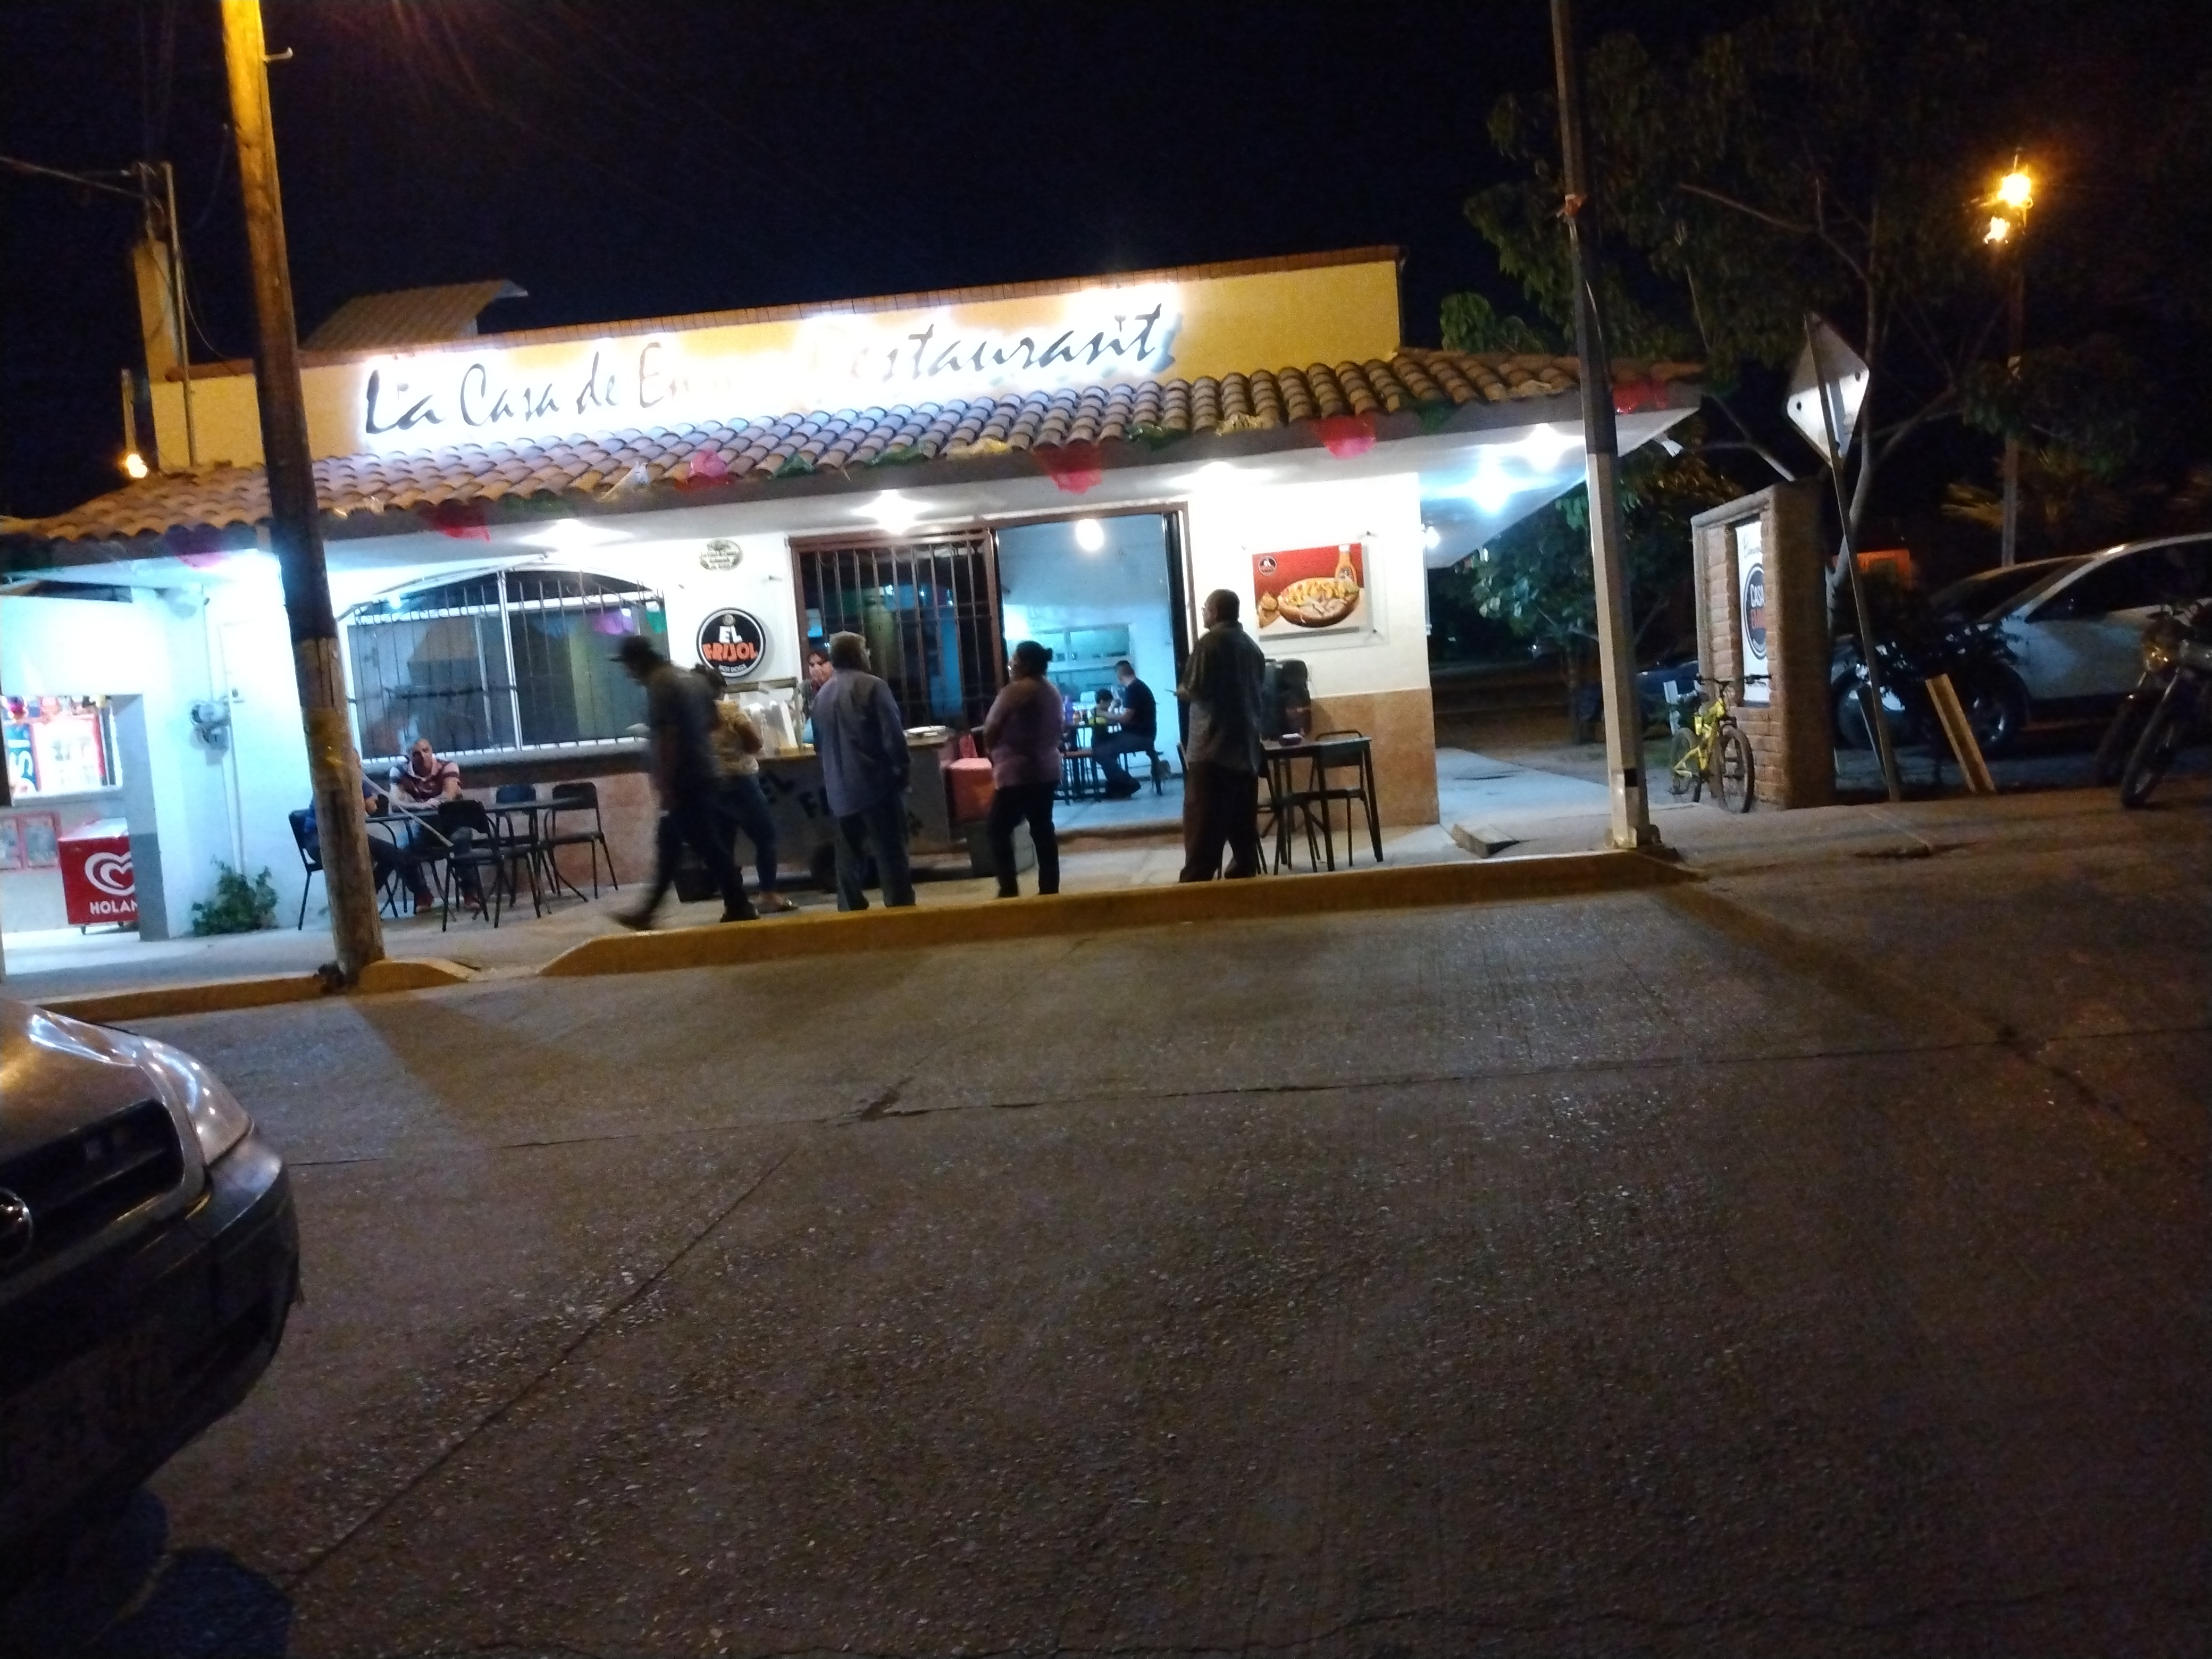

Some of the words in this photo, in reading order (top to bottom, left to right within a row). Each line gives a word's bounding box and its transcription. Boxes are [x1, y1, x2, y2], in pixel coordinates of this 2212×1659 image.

[366, 369, 447, 434] La
[460, 363, 559, 427] Casa
[576, 351, 618, 415] de
[811, 303, 1163, 382] estaurant
[719, 625, 743, 643] EL
[702, 641, 758, 663] FRIJOL
[731, 663, 748, 673] DOGS
